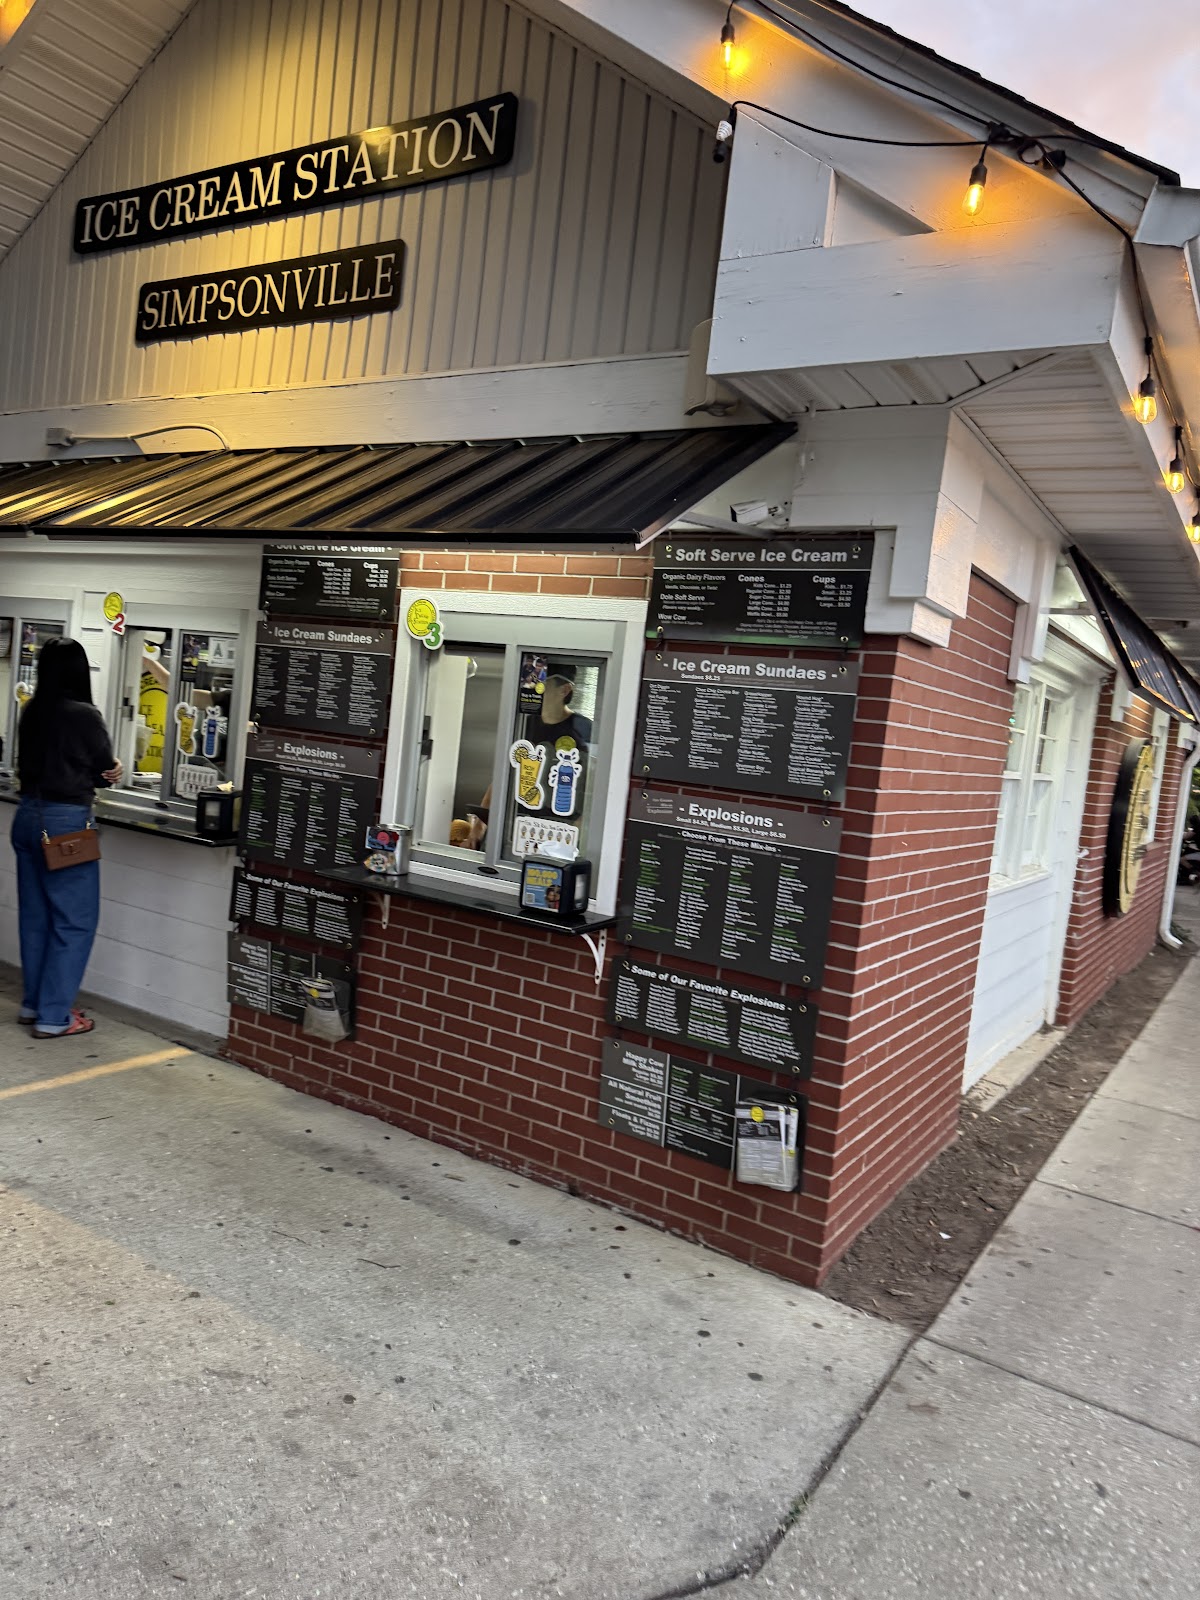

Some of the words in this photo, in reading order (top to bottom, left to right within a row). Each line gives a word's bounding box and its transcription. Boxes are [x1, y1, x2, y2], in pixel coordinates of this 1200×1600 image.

[80, 197, 140, 244] ICE
[148, 160, 286, 231] CREAM
[293, 102, 505, 201] STATION
[141, 252, 396, 331] SIMPSONVILLE
[676, 548, 706, 562] Soft
[710, 549, 756, 562] Serve
[760, 549, 786, 562] Ice
[791, 550, 848, 562] Cream
[662, 573, 686, 581] Organic
[686, 573, 702, 581] Dairy
[738, 574, 765, 582] Cones
[813, 575, 836, 584] Cups
[112, 613, 125, 632] 2
[274, 627, 290, 637] Ice
[292, 628, 325, 640] Cream
[327, 630, 373, 644] Sundaes
[425, 623, 440, 646] 3
[214, 643, 223, 657] A
[673, 658, 695, 672] Ice
[700, 660, 750, 675] Cream
[755, 663, 826, 680] Sundaes
[283, 742, 338, 760] Explosions
[688, 803, 773, 828] Explosions
[676, 816, 692, 824] Small
[710, 821, 733, 830] Medium
[751, 828, 769, 837] Large
[682, 831, 707, 841] Choose
[708, 834, 726, 844] From
[727, 837, 749, 848] These
[750, 840, 776, 853] Mix-ins
[246, 873, 264, 883] Some
[271, 880, 284, 888] Our
[284, 881, 309, 894] Favorite
[310, 887, 345, 902] Explosions
[631, 965, 657, 978] Some
[658, 972, 669, 981] of
[670, 975, 688, 986] Our
[689, 979, 729, 996] Favorite
[730, 990, 786, 1011] Explosions
[626, 1051, 647, 1064] Happy
[648, 1058, 664, 1068] Cow
[638, 1063, 663, 1075] Shakes
[608, 1080, 617, 1088] All
[619, 1083, 644, 1096] Natural
[645, 1091, 662, 1102] Fruit
[625, 1092, 661, 1110] Smoothies
[612, 1109, 631, 1120] Floats
